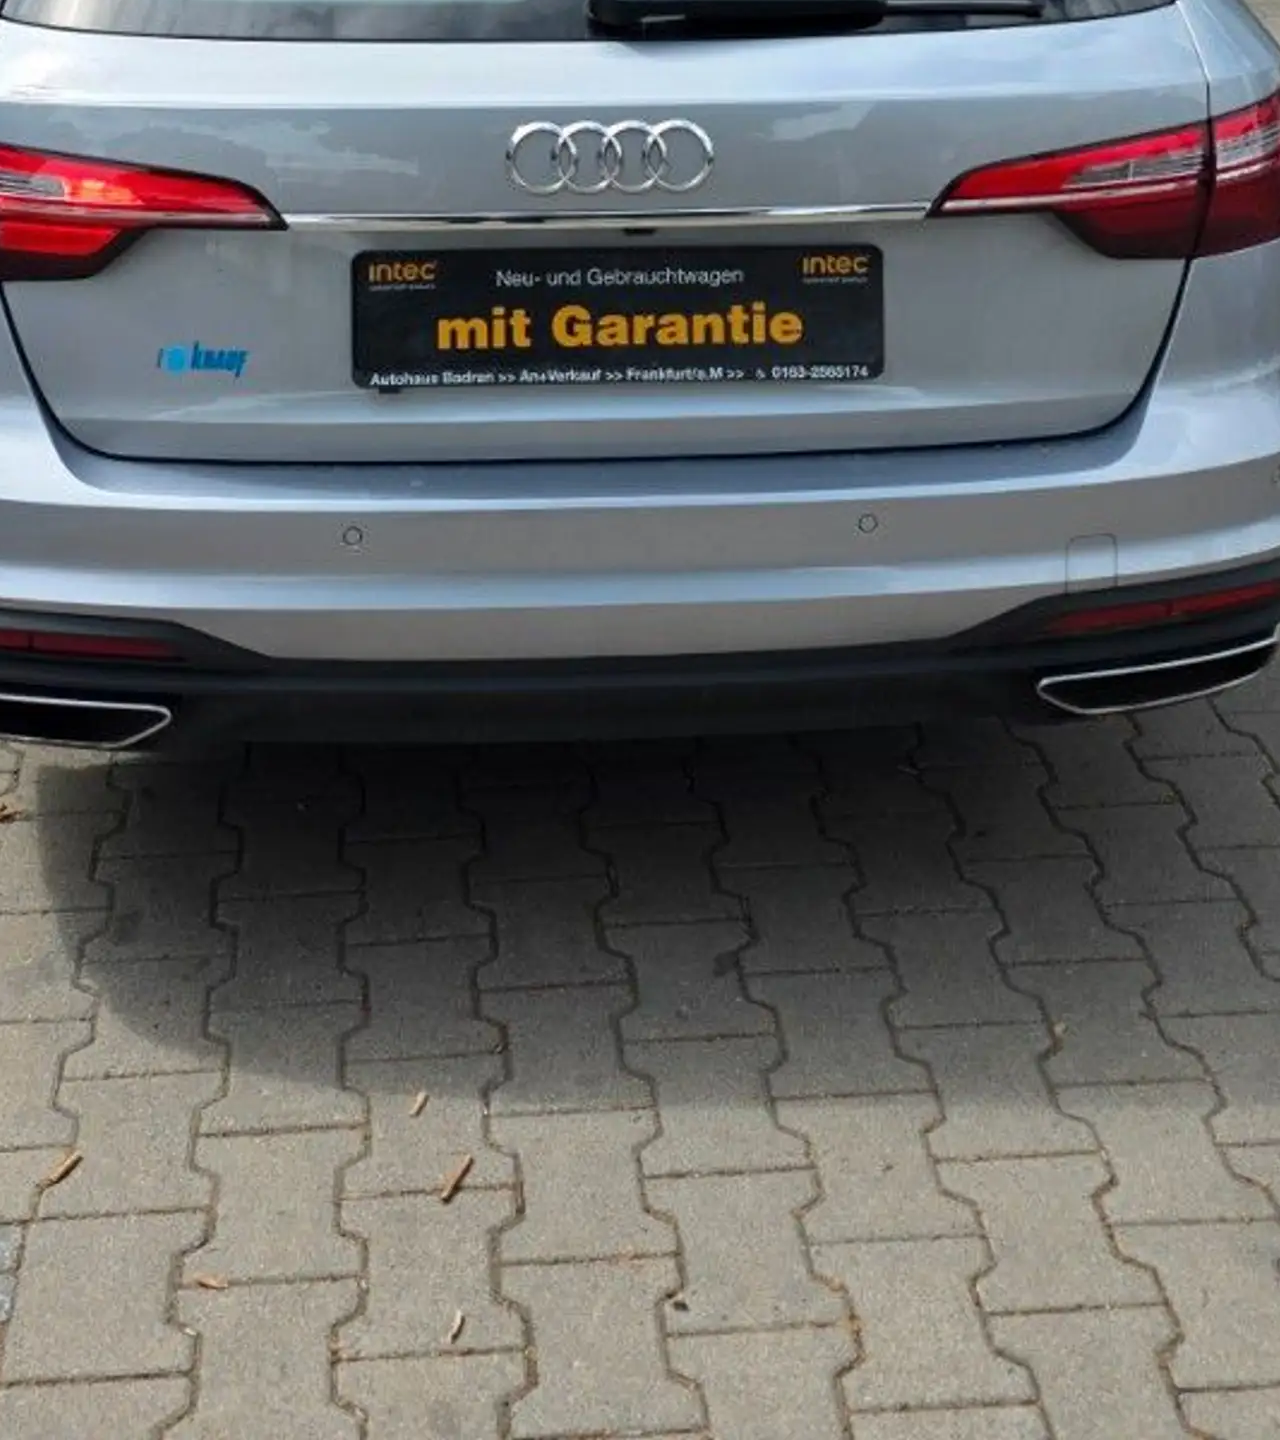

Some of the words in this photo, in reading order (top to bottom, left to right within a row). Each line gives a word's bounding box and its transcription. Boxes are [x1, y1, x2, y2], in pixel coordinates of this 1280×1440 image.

[369, 261, 437, 282] intec
[802, 255, 869, 275] intec
[496, 270, 540, 288] Neu-
[547, 269, 581, 287] und
[587, 266, 745, 288] Gebrauchtwagen
[437, 306, 533, 350] mit
[552, 300, 803, 348] Garantie
[370, 371, 439, 386] Autohaus
